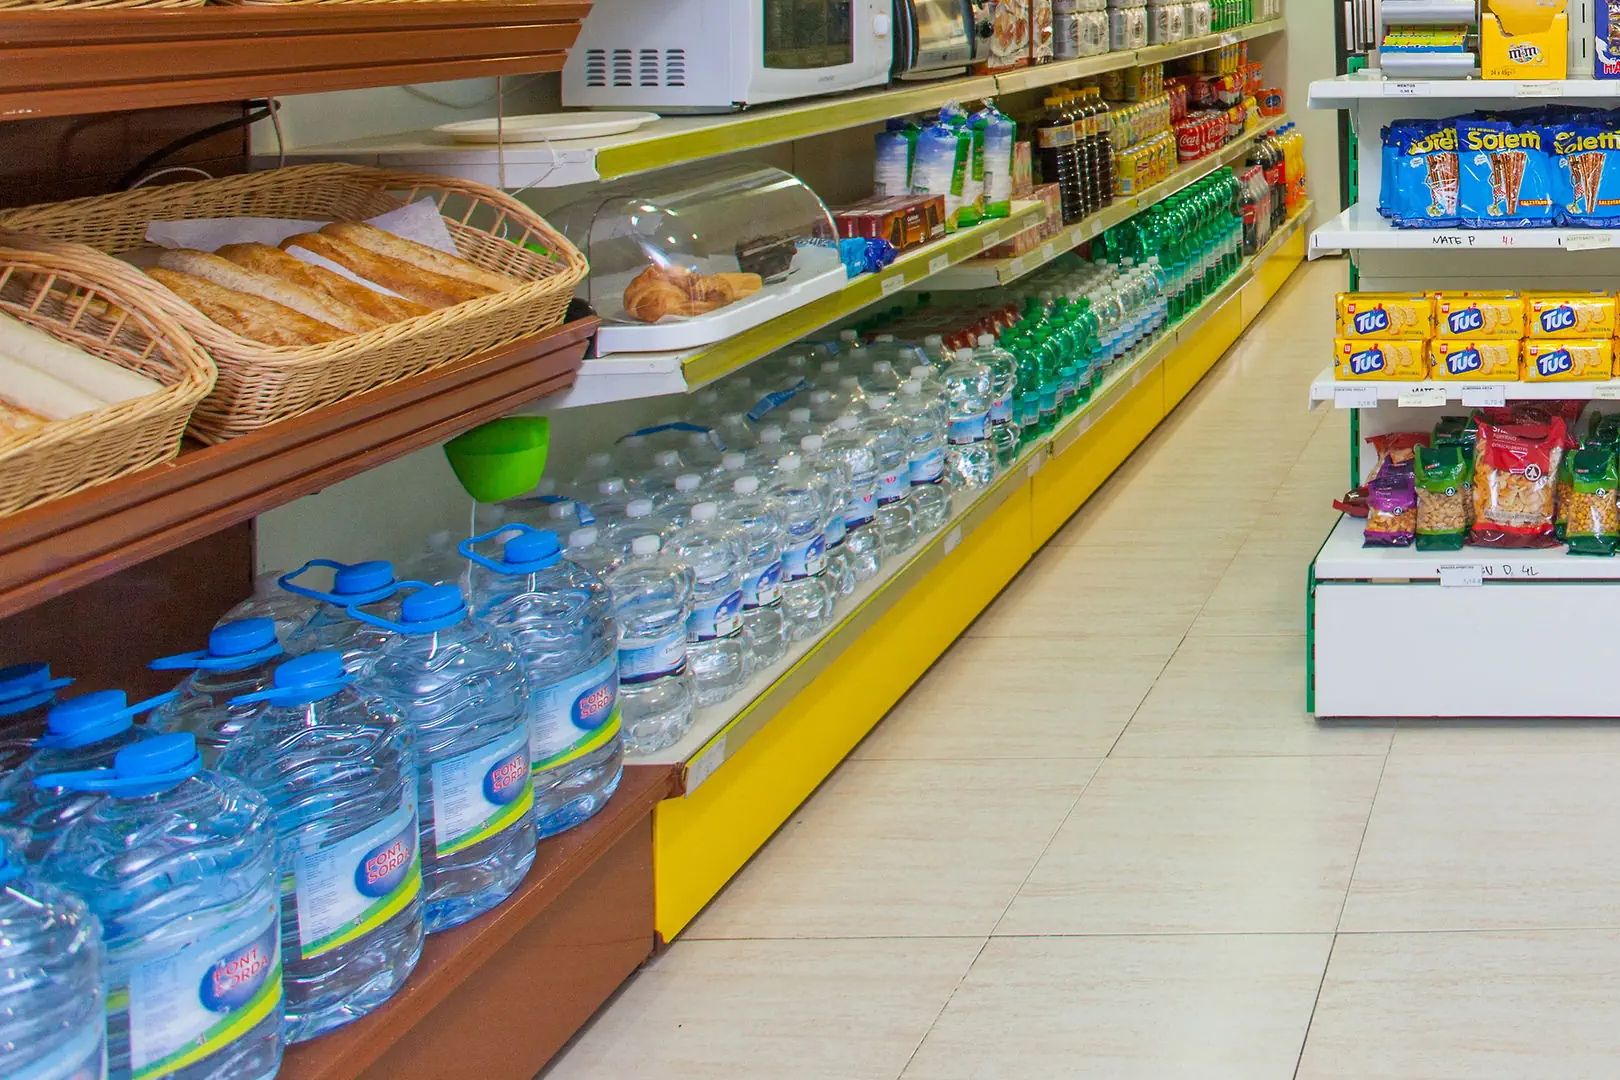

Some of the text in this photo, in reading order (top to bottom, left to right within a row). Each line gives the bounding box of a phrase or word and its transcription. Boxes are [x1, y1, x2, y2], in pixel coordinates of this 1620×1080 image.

[1467, 235, 1476, 246] P
[1356, 313, 1386, 333] TUC
[1450, 312, 1480, 332] TUC
[1542, 311, 1573, 331] TUC
[1352, 354, 1382, 373] TUC
[1448, 353, 1478, 373] TUC
[1539, 354, 1569, 373] TUC
[579, 685, 609, 708] FONT
[492, 756, 523, 780] FONT
[366, 840, 402, 871] FONT
[367, 848, 410, 884] SORDA
[213, 947, 261, 982] FONT
